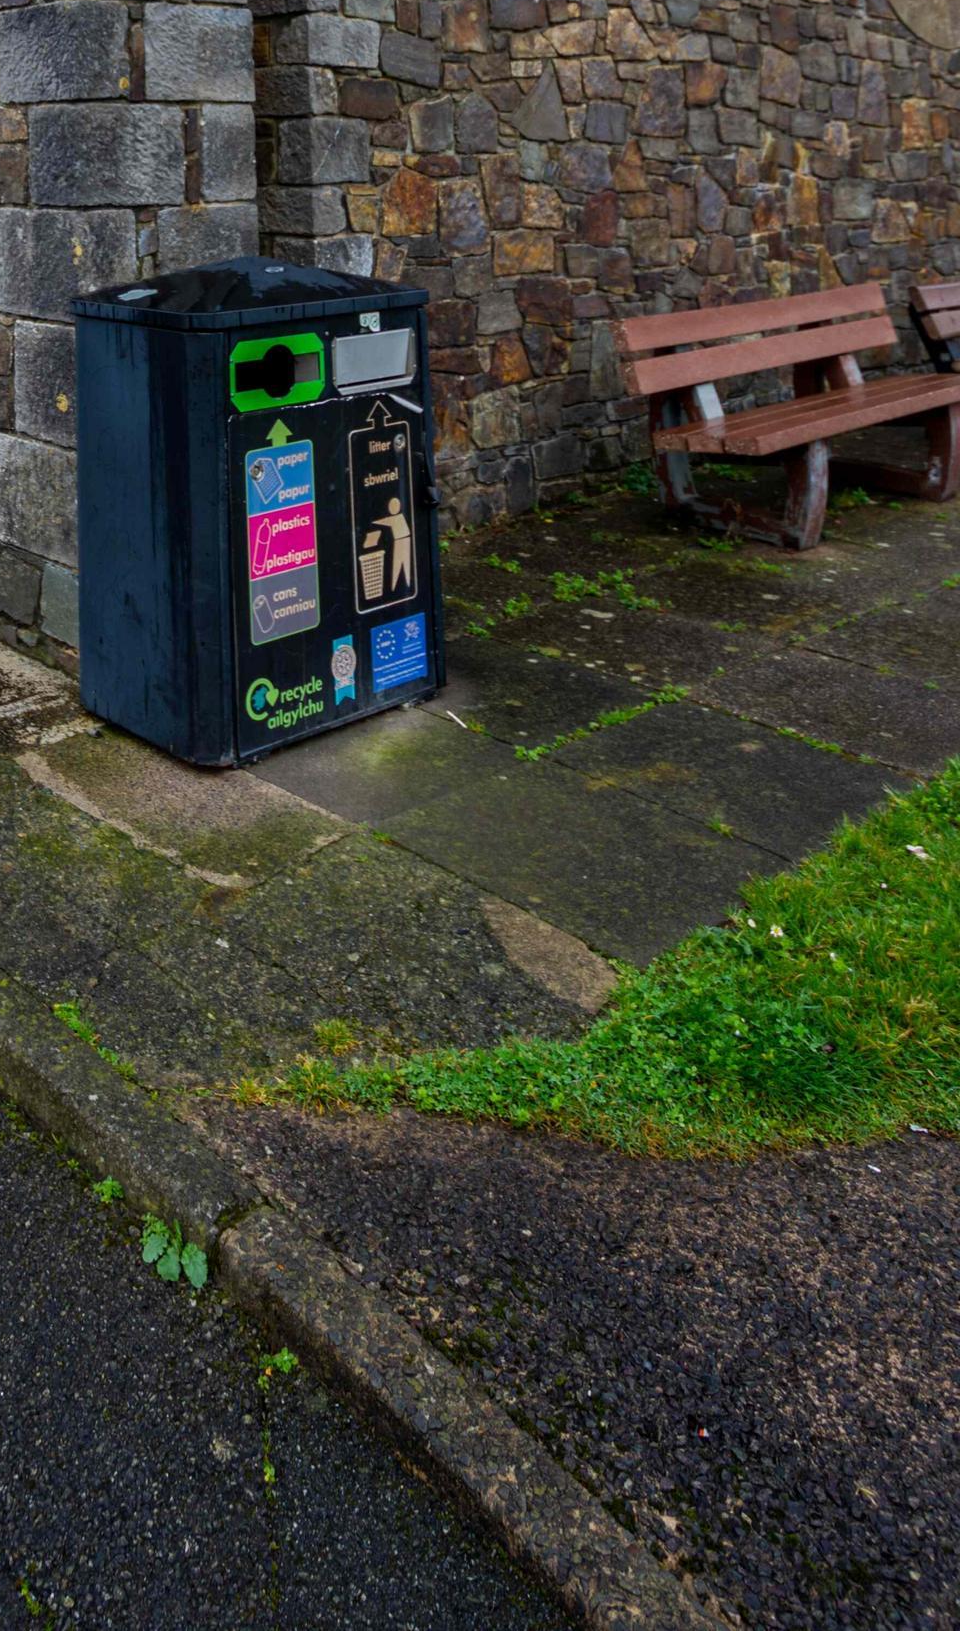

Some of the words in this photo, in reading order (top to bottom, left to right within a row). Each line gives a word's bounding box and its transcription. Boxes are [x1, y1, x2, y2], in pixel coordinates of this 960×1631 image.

[368, 440, 391, 454] litter
[277, 451, 309, 470] paper
[363, 467, 399, 487] sbwriel
[278, 484, 310, 503] papur
[272, 514, 310, 537] plastics
[266, 548, 315, 573] plastigau
[273, 587, 297, 602] cans
[273, 598, 316, 619] canniau
[281, 675, 323, 704] recycle
[267, 699, 324, 729] ailgylchu
